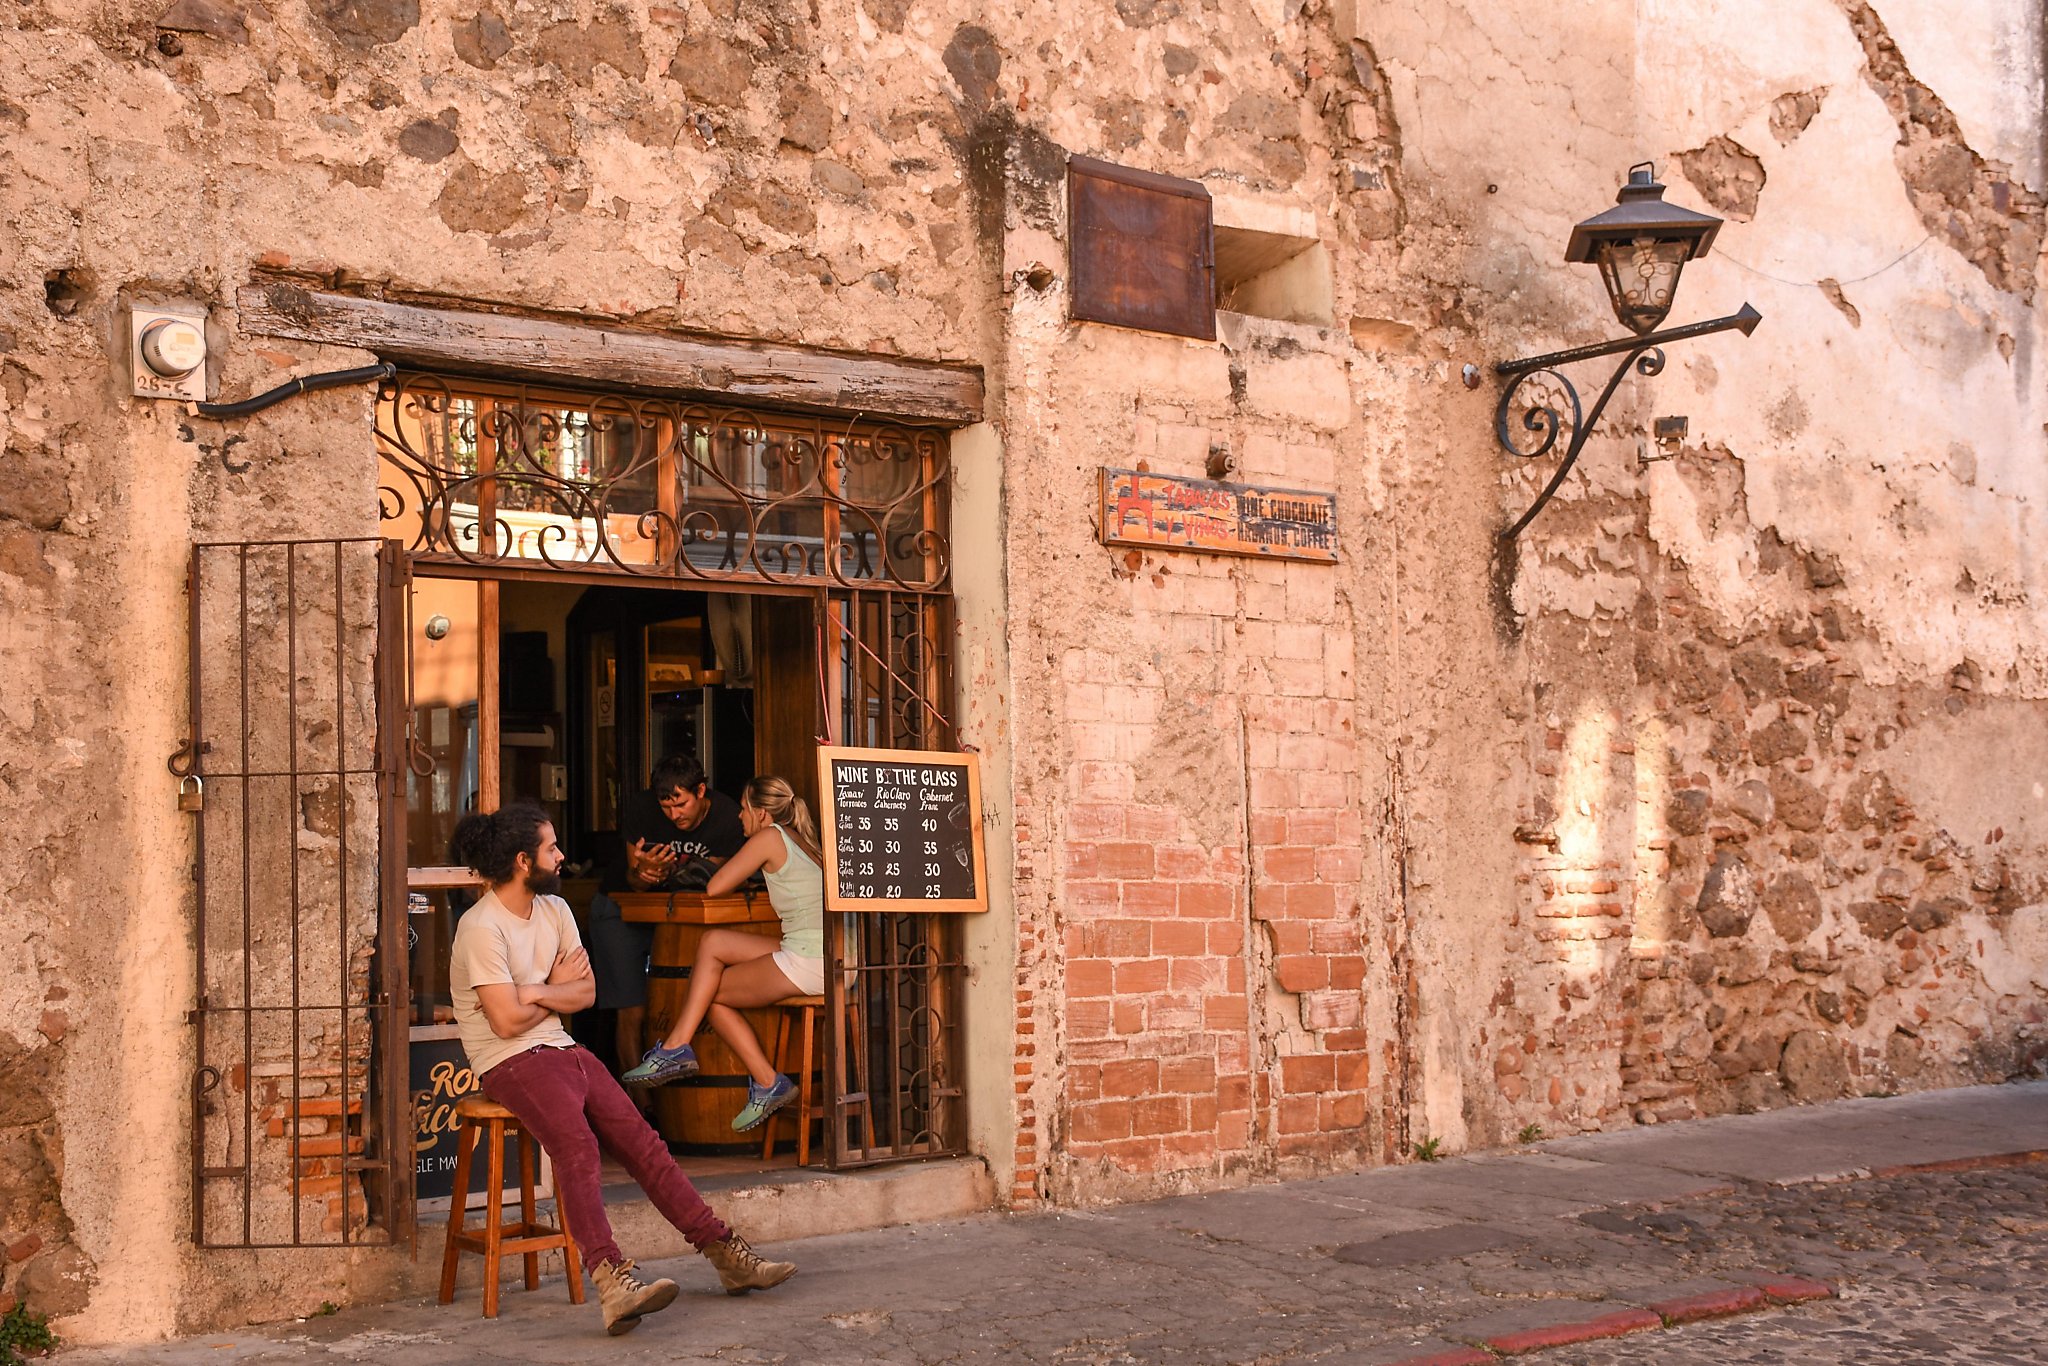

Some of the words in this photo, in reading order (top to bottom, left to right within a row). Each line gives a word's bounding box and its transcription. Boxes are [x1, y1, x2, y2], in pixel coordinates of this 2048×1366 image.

[837, 766, 869, 784] WINE
[892, 768, 917, 786] THE
[920, 769, 958, 787] GLASS
[919, 788, 954, 802] Cabernet
[858, 817, 871, 830] 35
[884, 818, 899, 831] 35
[921, 819, 937, 832] 40
[858, 839, 873, 853] 30
[885, 841, 900, 854] 30
[923, 841, 938, 855] 35
[859, 862, 874, 876] 25
[885, 863, 900, 876] 25
[924, 863, 941, 877] 30
[859, 885, 874, 898] 20
[886, 885, 901, 898] 20
[925, 885, 941, 899] 25
[439, 1155, 458, 1171] MA
